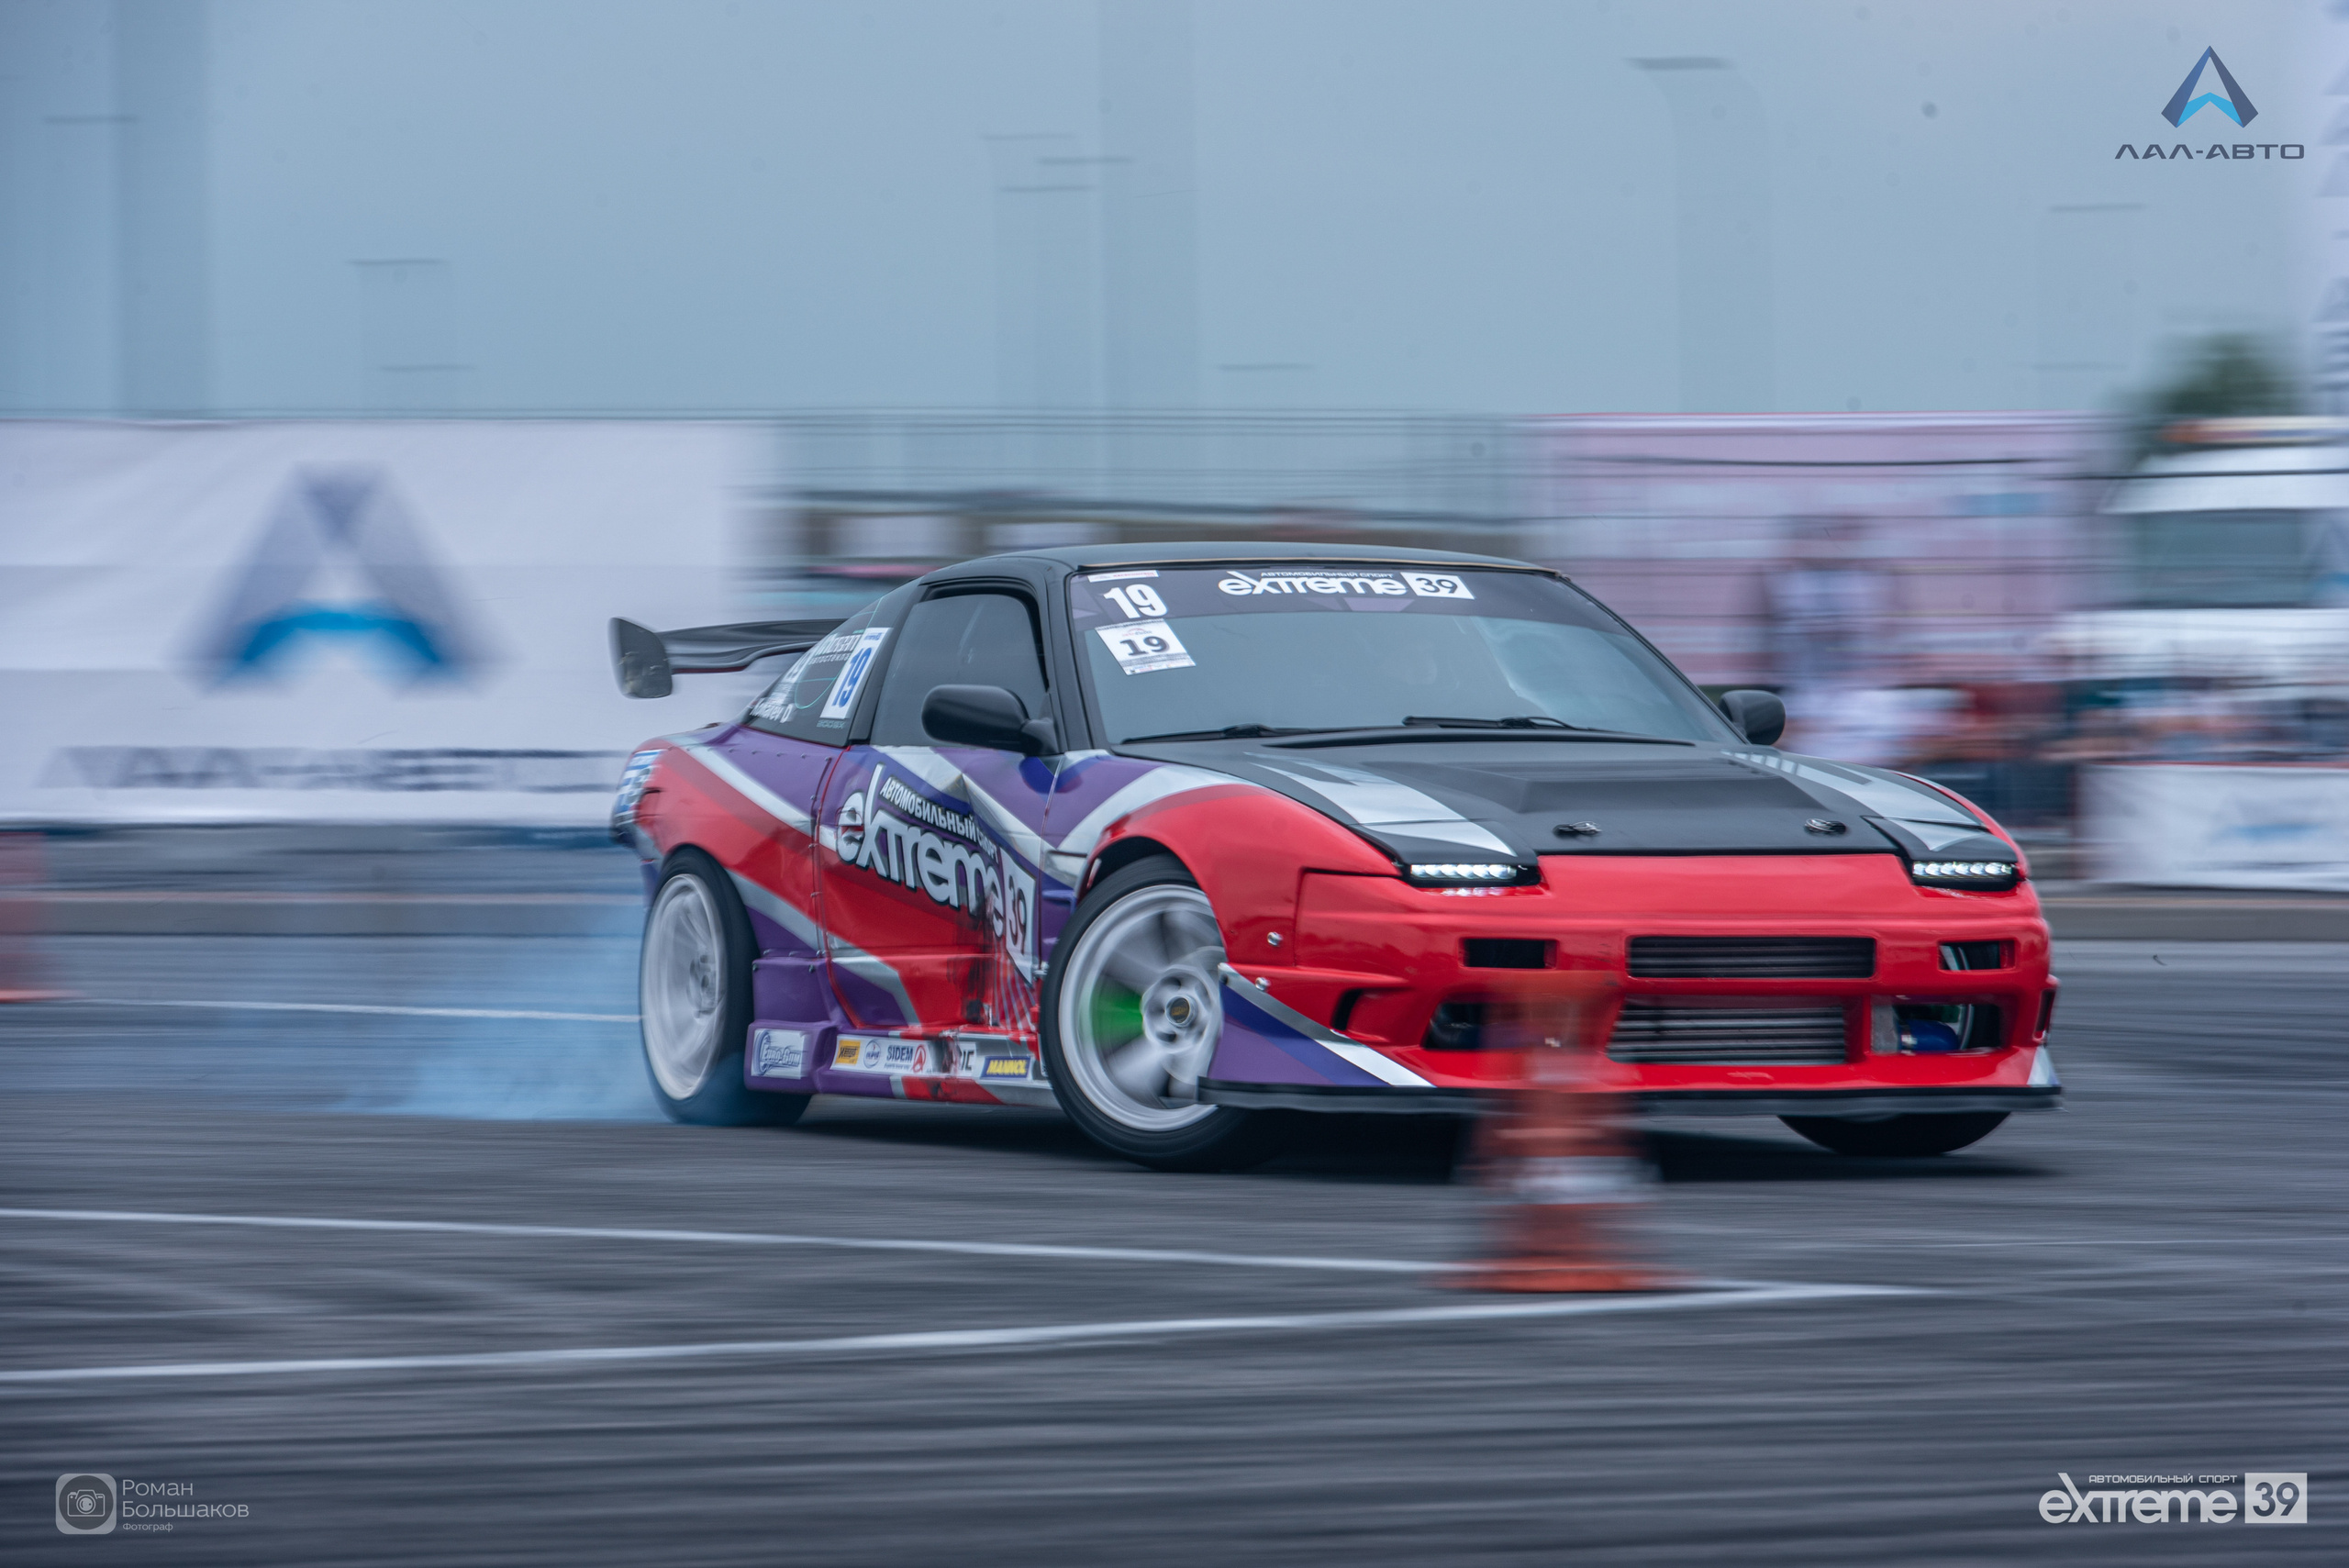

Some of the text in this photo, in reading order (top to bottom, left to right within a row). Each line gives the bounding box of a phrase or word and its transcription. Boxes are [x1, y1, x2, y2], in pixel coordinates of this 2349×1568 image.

[1103, 584, 1169, 619] 19
[1415, 577, 1460, 595] 39
[1119, 636, 1170, 656] 19
[831, 647, 873, 708] 19
[879, 776, 977, 843] АВТОМОБИЛЬНЫЙ
[1008, 874, 1028, 956] 39
[886, 1045, 913, 1062] SIDEM
